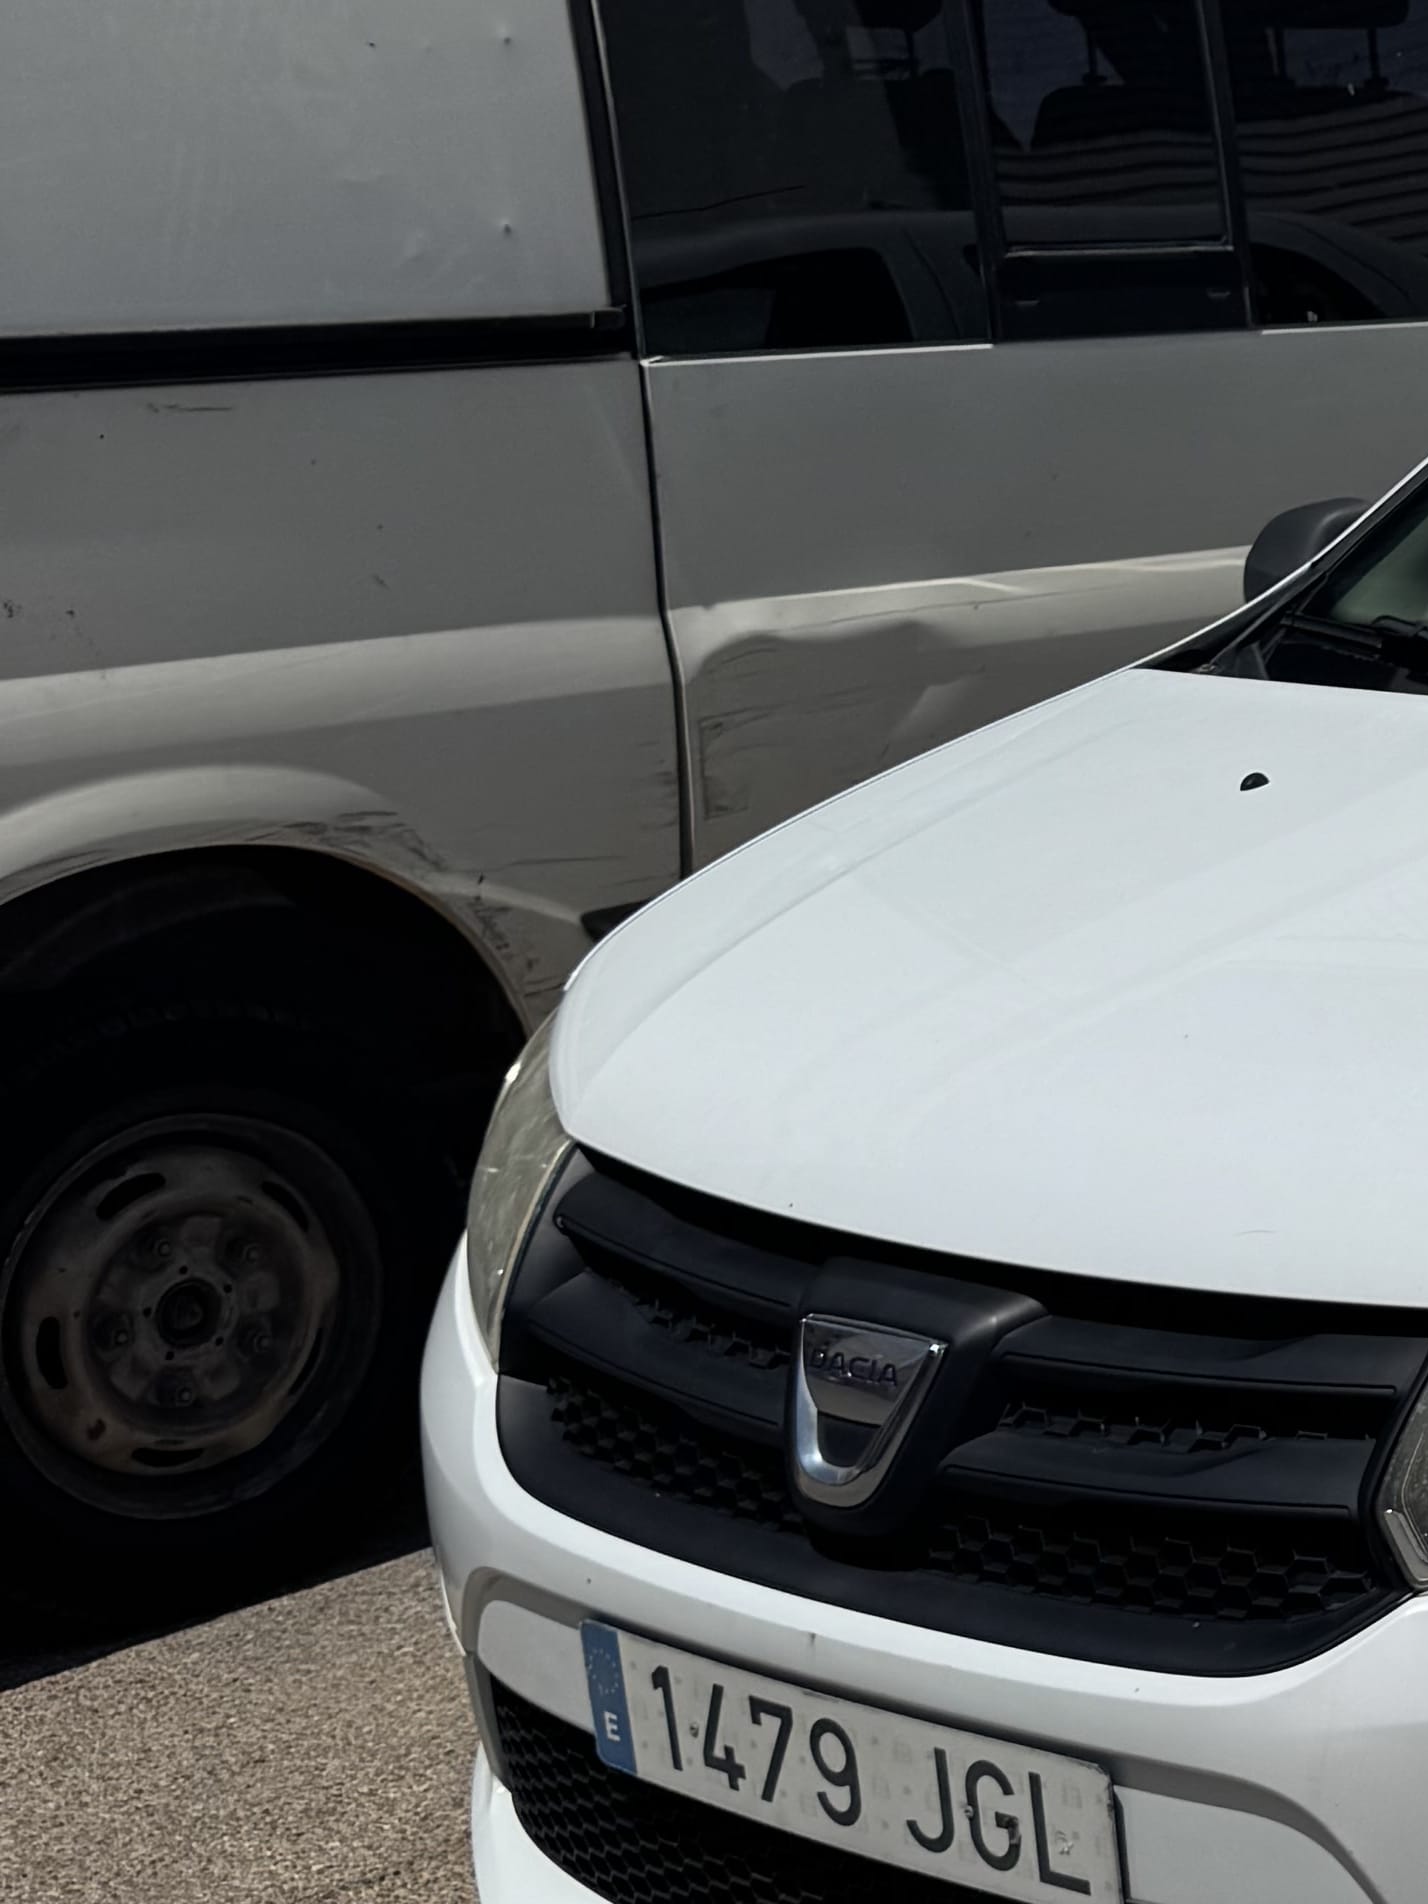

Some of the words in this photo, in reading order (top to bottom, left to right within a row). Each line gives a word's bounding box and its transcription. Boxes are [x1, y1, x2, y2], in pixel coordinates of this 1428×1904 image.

[808, 1346, 897, 1386] DACIA
[603, 1711, 621, 1743] E
[651, 1665, 862, 1827] 1479
[906, 1747, 1091, 1897] JGL
